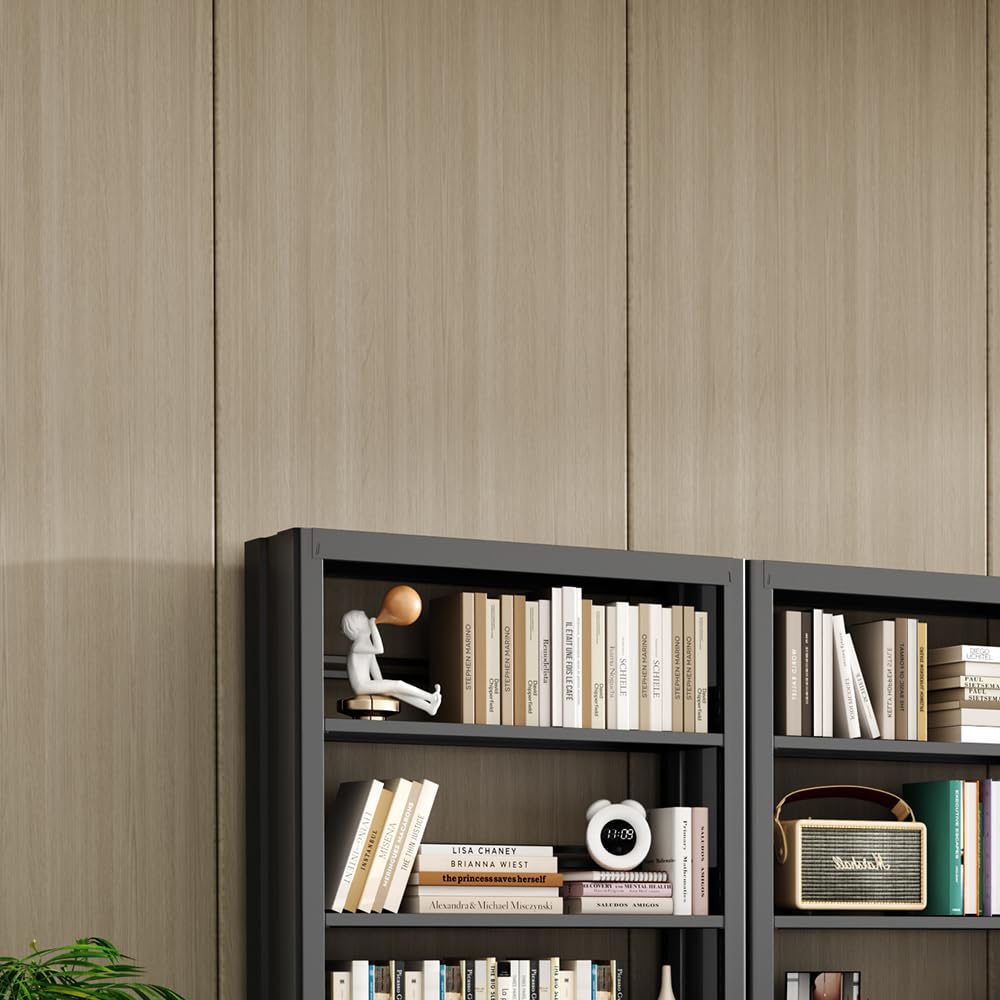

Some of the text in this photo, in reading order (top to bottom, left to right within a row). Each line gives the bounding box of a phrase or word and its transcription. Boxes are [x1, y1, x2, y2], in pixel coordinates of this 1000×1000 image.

[566, 676, 573, 684] LE
[404, 841, 415, 857] THIN
[410, 814, 425, 840] JUSTICE
[606, 828, 634, 840] 11:09
[379, 822, 397, 860] MISENA
[360, 830, 378, 871] INSTANBUL
[452, 846, 518, 855] LISA CHANEY
[450, 860, 530, 868] BRIANNA WIEST
[431, 900, 469, 910] Alexandra
[479, 900, 509, 910] Michael
